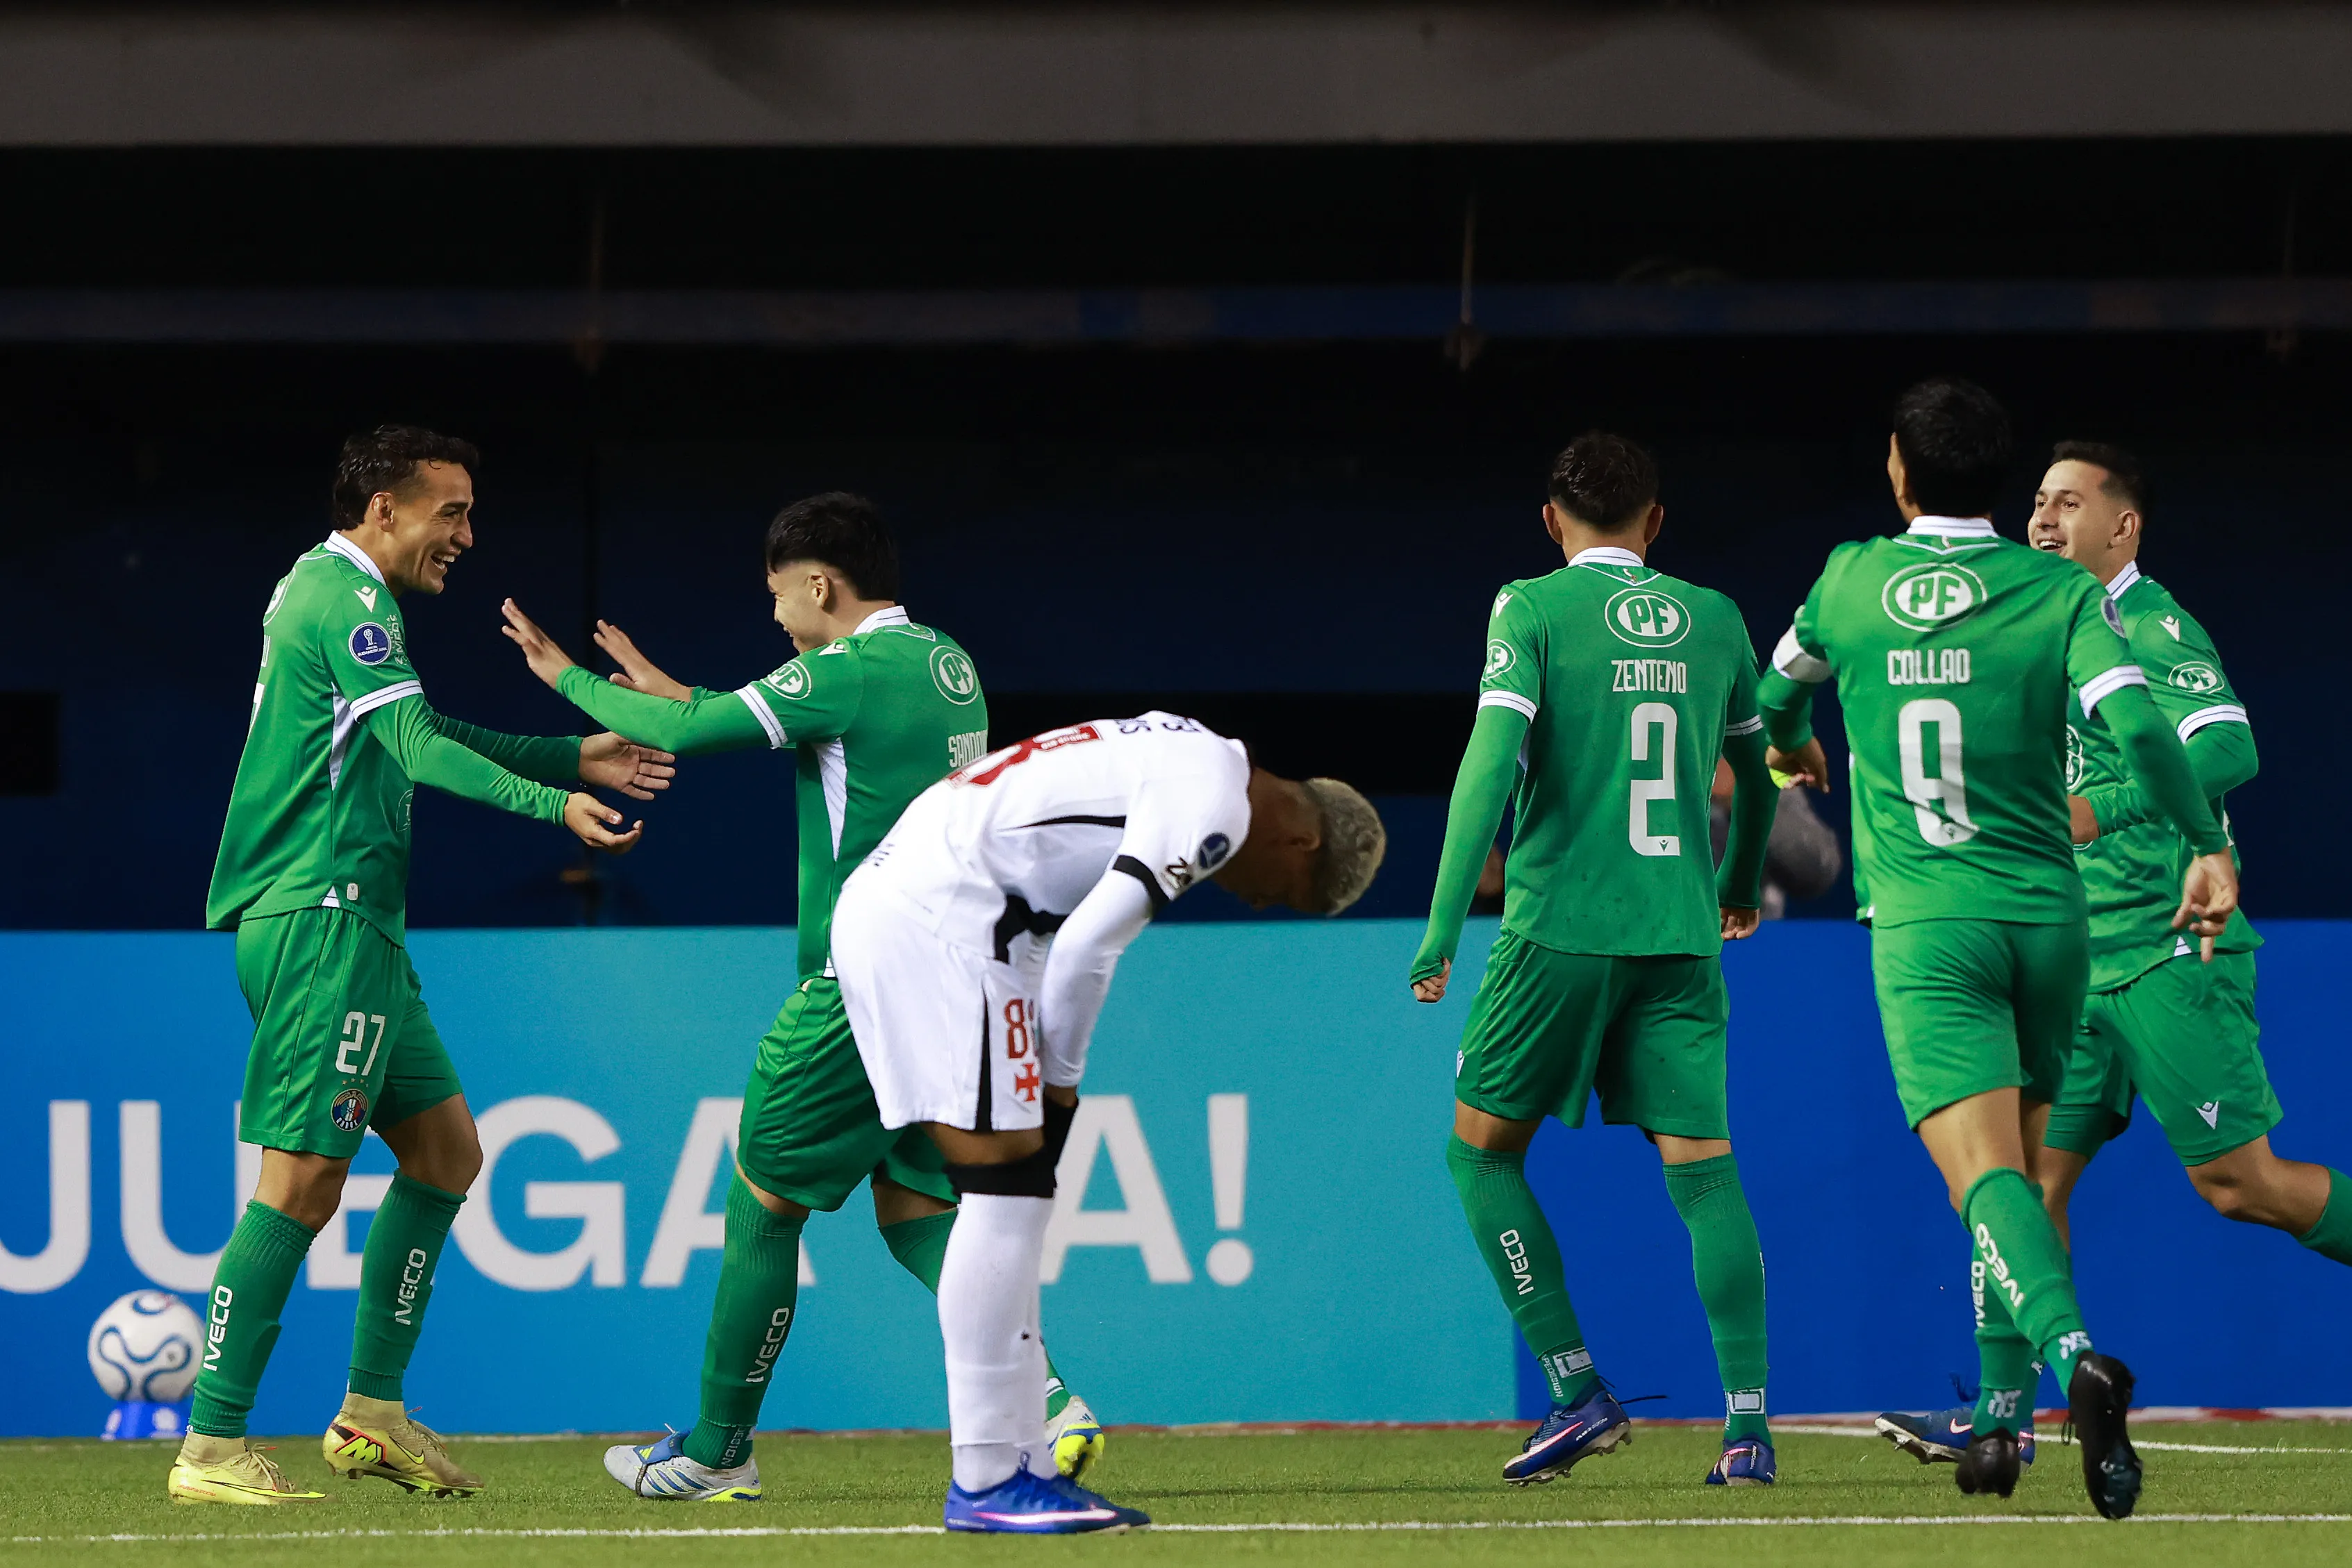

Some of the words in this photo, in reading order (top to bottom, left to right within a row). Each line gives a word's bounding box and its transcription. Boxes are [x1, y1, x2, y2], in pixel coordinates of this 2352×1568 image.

[1625, 597, 1668, 635] PF
[1909, 575, 1962, 616] PF
[941, 651, 972, 690] PF
[1611, 658, 1687, 694] ZENTENO
[1887, 648, 1971, 685] COLLAO
[1628, 702, 1680, 856] 2
[1898, 698, 1980, 848] 9
[336, 1011, 386, 1076] 27
[395, 1248, 426, 1326] IVECO
[1499, 1229, 1534, 1296] IVECO
[1971, 1260, 1986, 1328] IVECO
[1976, 1223, 2025, 1308] IVECO
[203, 1285, 234, 1371] IVECO
[745, 1307, 790, 1383] IVECO
